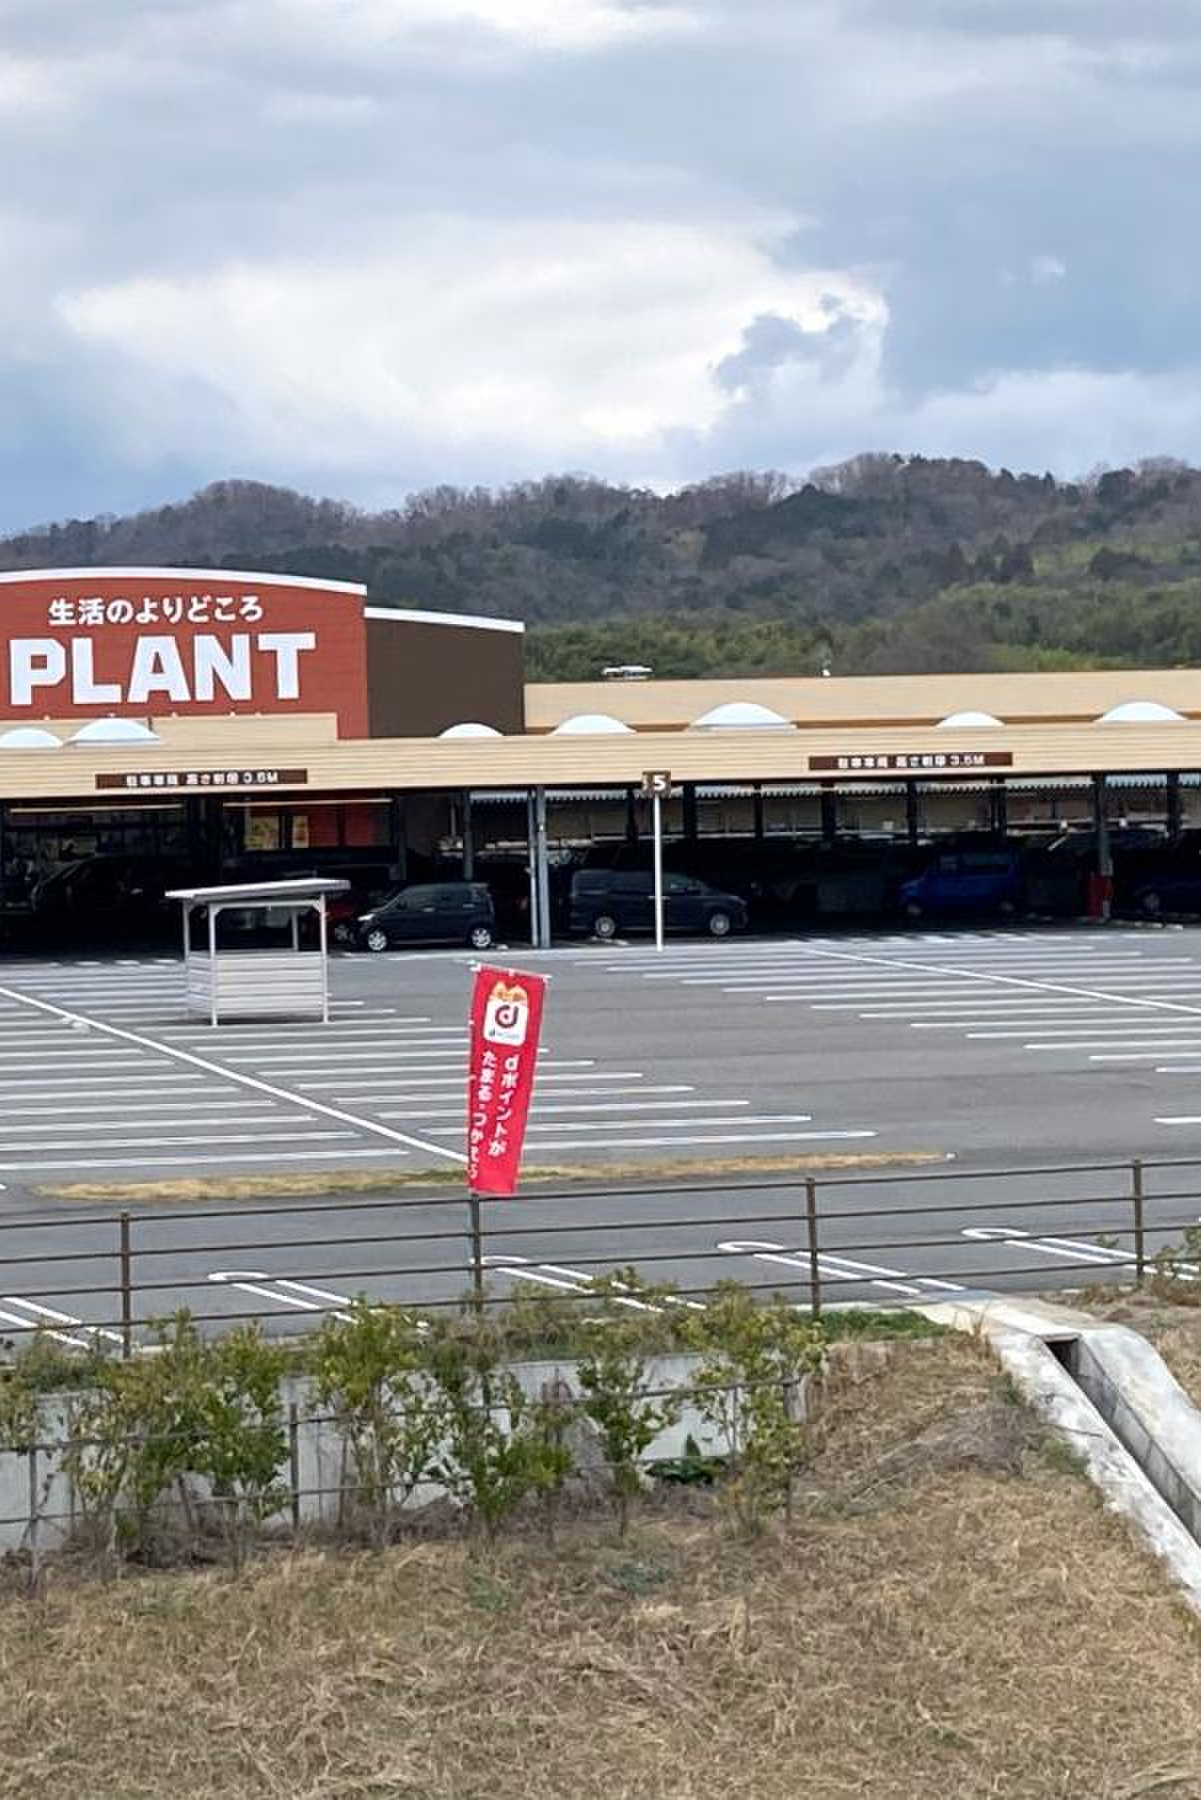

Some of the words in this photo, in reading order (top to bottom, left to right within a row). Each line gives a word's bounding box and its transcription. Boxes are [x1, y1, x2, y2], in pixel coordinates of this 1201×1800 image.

[47, 594, 265, 627] 生活のよりどころ
[8, 632, 317, 706] PLANT
[652, 774, 667, 791] 5
